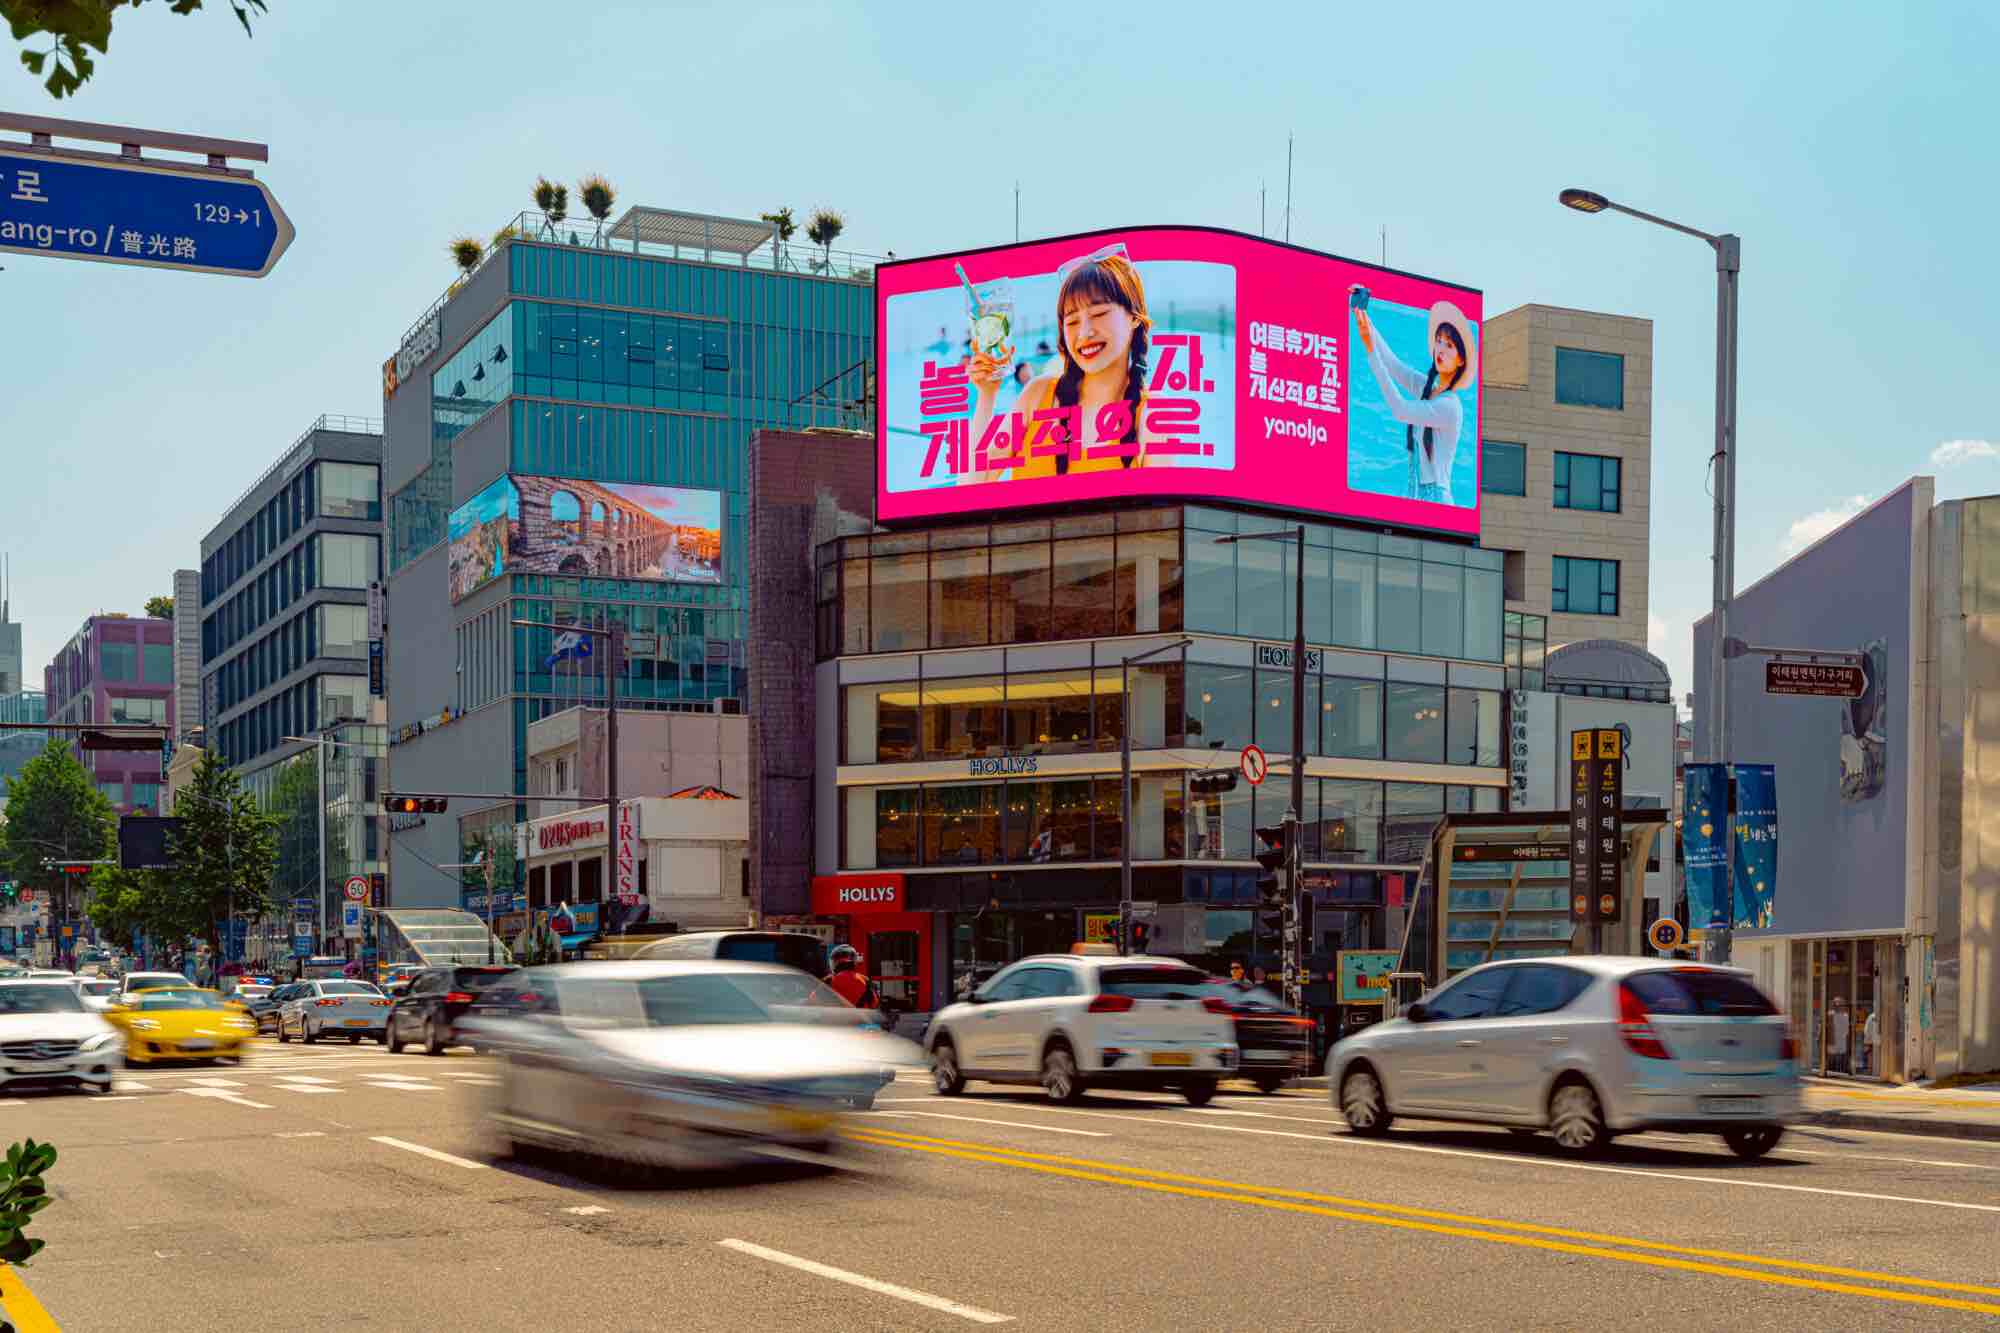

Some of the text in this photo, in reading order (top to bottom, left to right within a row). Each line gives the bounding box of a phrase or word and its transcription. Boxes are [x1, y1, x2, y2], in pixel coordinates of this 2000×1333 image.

[0, 170, 48, 202] 로
[193, 203, 261, 228] 129 1
[0, 221, 97, 248] ang-ro
[120, 230, 198, 259] 普光路
[1149, 335, 1215, 393] 자.
[1263, 416, 1328, 447] yanolja
[1260, 646, 1320, 670] HOLS
[970, 757, 1039, 776] HOLLYS
[1576, 765, 1586, 780] 4
[1603, 763, 1615, 780] 4
[1602, 793, 1615, 854] 이태원
[619, 803, 633, 893] TRANS
[839, 887, 895, 903] HOLLYS
